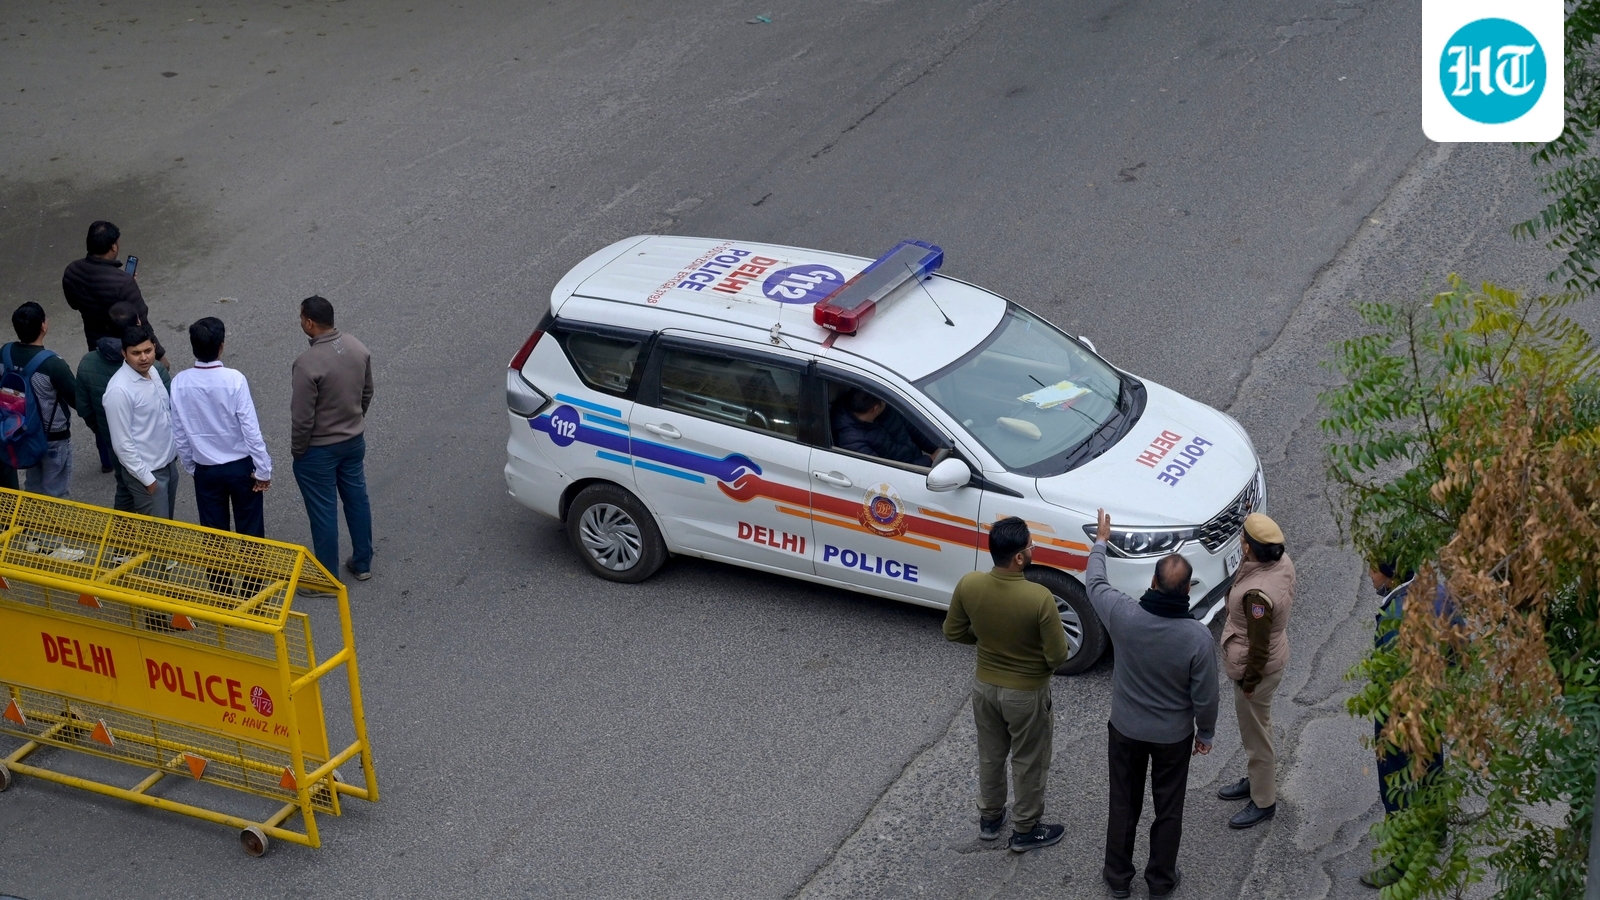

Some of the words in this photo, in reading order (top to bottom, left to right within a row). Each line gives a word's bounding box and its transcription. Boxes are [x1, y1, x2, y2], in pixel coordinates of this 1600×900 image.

[677, 248, 752, 292] POLICE
[712, 255, 779, 294] DELHI
[767, 270, 836, 299] C112
[551, 415, 577, 439] C112
[738, 521, 806, 554] DELHI
[823, 544, 919, 582] POLICE
[41, 632, 117, 678] DELHI
[145, 658, 246, 712] POLICE
